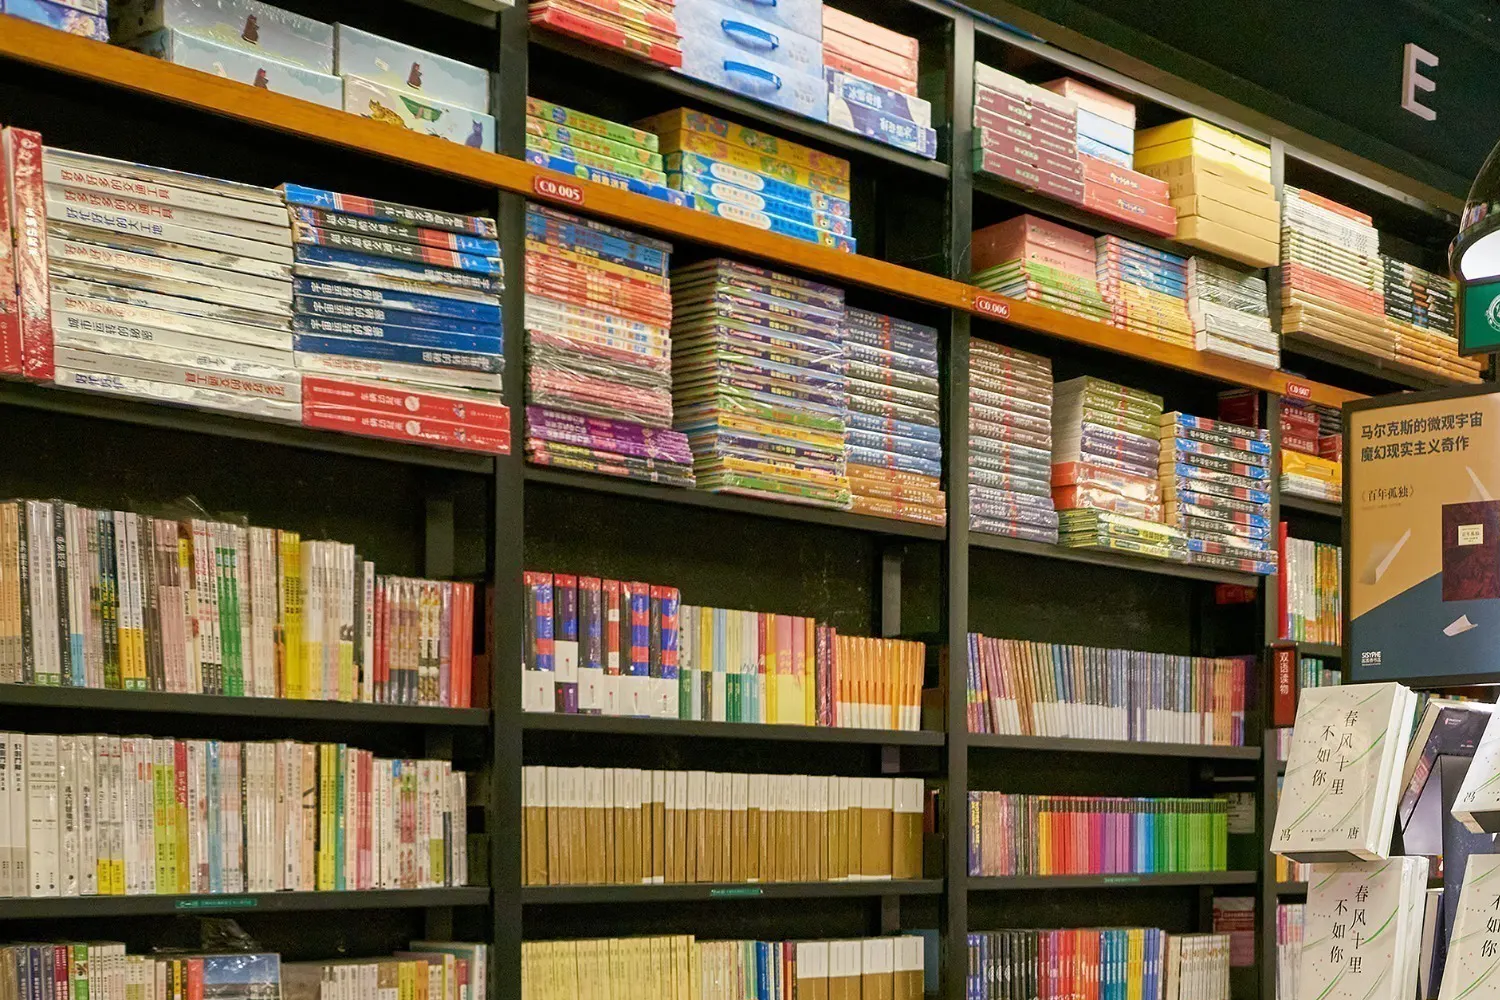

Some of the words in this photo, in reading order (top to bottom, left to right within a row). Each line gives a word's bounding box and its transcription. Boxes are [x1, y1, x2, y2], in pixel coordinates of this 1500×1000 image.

[1402, 42, 1439, 121] E
[61, 169, 170, 199] 好多好多的交通工具
[64, 190, 174, 219] 好多好多的交通工具
[66, 207, 163, 235] 好忙好忙的大工地
[1361, 411, 1483, 440] 马尔克斯的微观宇宙
[1361, 436, 1469, 462] 魔幻现实主义奇作
[1361, 484, 1416, 502] 《百年孤独》
[1279, 652, 1290, 696] 双语读物
[1311, 725, 1336, 787] 不如你
[1330, 710, 1359, 796] 春风十里
[1463, 790, 1476, 803] 冯
[1279, 828, 1292, 842] 冯
[1348, 826, 1360, 840] 唐
[1331, 899, 1349, 963] 不如你
[1348, 885, 1369, 974] 春风十里
